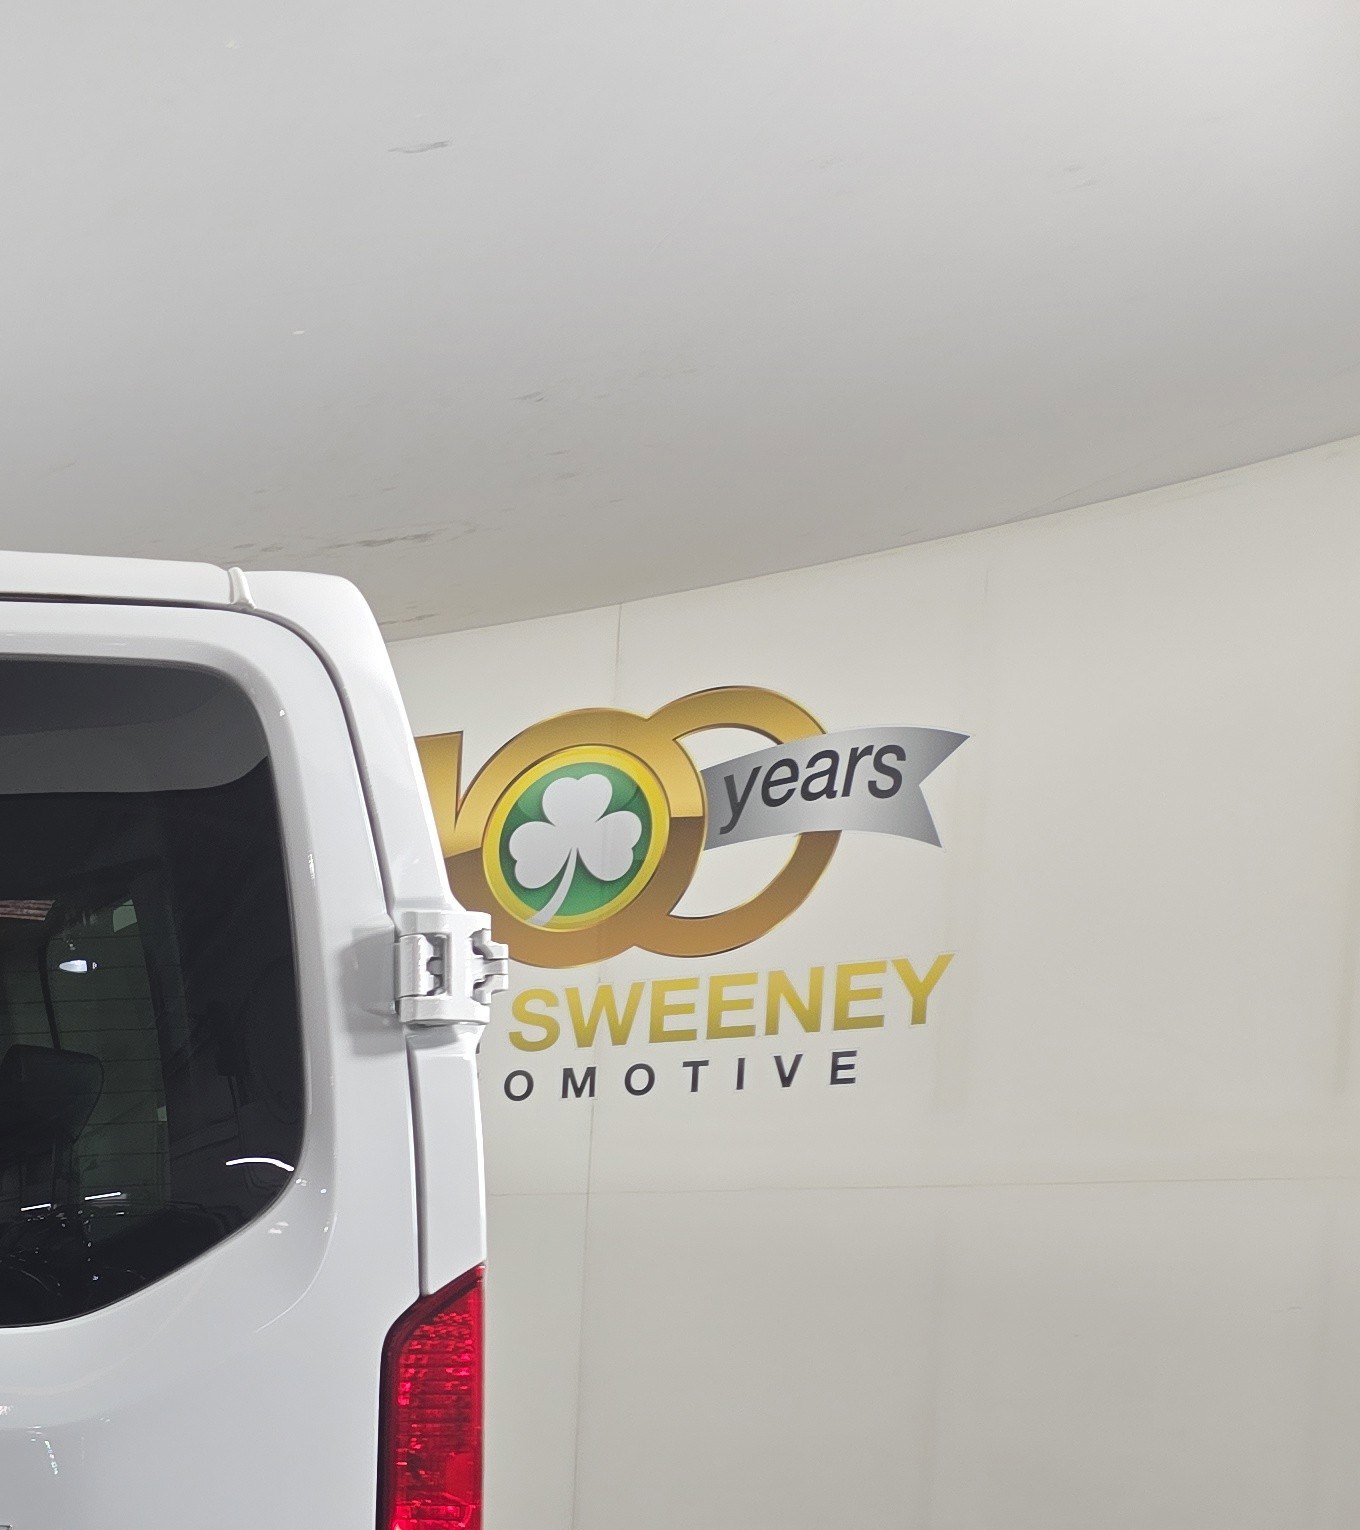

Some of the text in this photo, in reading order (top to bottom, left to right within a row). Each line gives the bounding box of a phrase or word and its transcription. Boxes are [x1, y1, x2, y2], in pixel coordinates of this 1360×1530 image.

[719, 743, 906, 834] years
[508, 953, 955, 1053] SWEENEY
[502, 1050, 859, 1102] OMOTIVE
